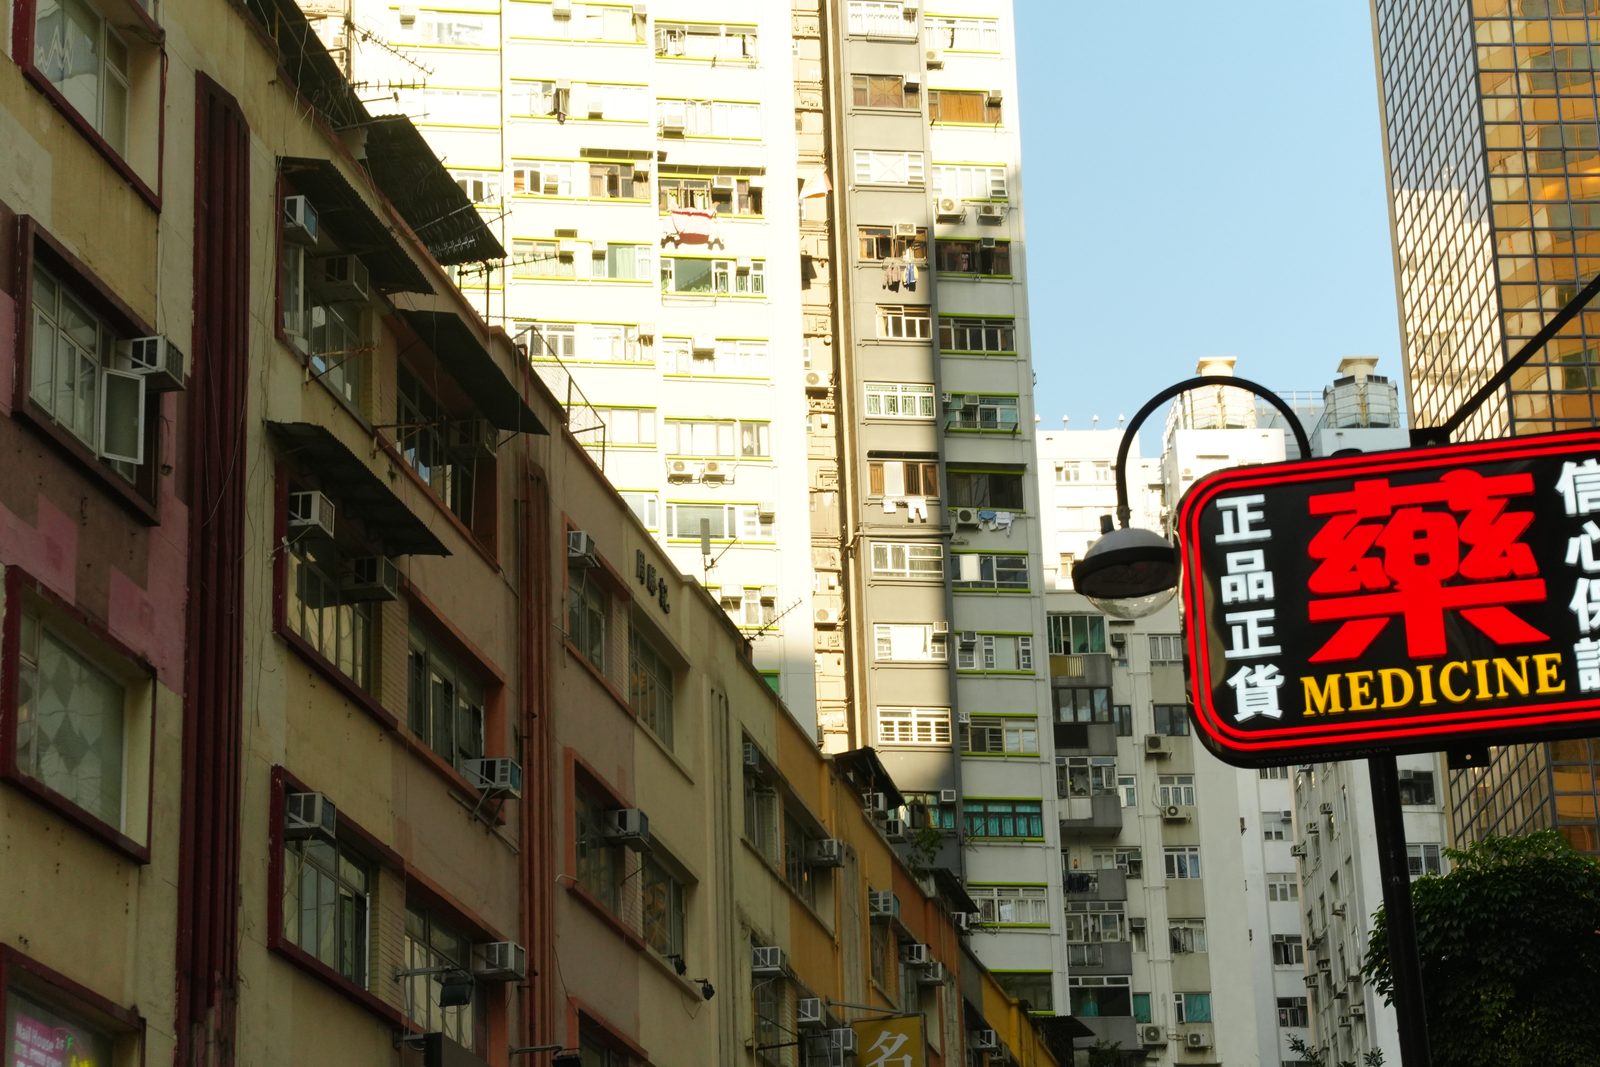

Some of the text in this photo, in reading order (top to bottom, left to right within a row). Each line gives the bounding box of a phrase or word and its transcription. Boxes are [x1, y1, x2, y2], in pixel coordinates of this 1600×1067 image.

[1215, 494, 1285, 722] 正品正貨
[1308, 469, 1551, 663] 藥
[1300, 652, 1566, 717] MEDICINE
[866, 1030, 913, 1067] 名
